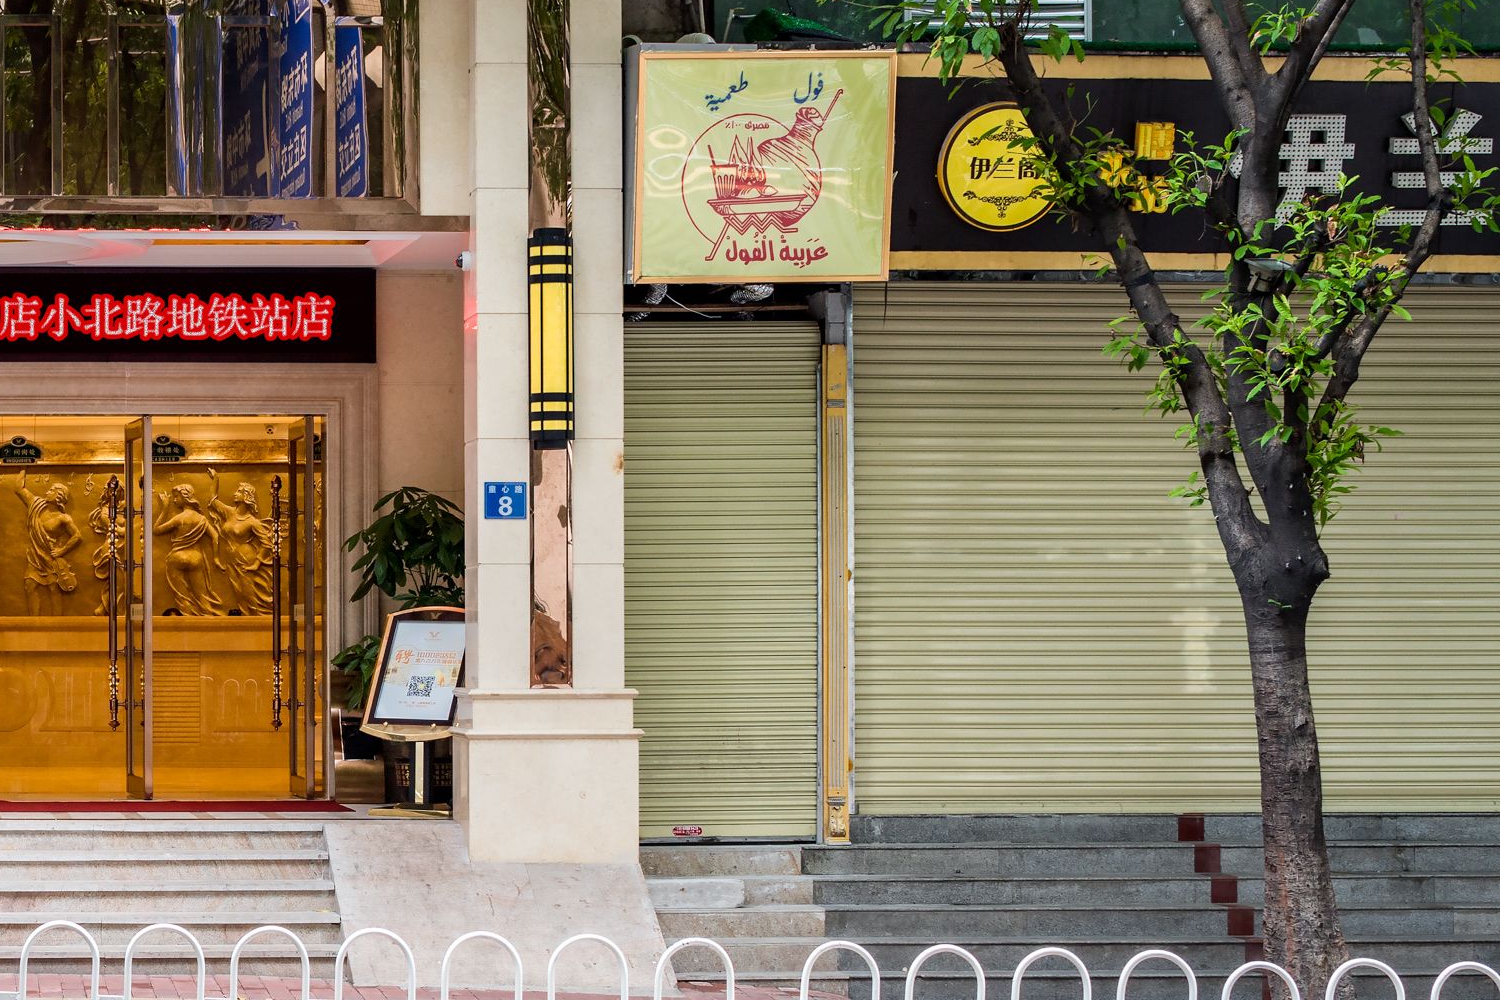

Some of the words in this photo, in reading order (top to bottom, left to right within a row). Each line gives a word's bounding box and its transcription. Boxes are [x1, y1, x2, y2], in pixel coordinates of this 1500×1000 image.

[704, 70, 749, 111] طعمية
[793, 72, 824, 104] فول
[498, 496, 513, 516] 8
